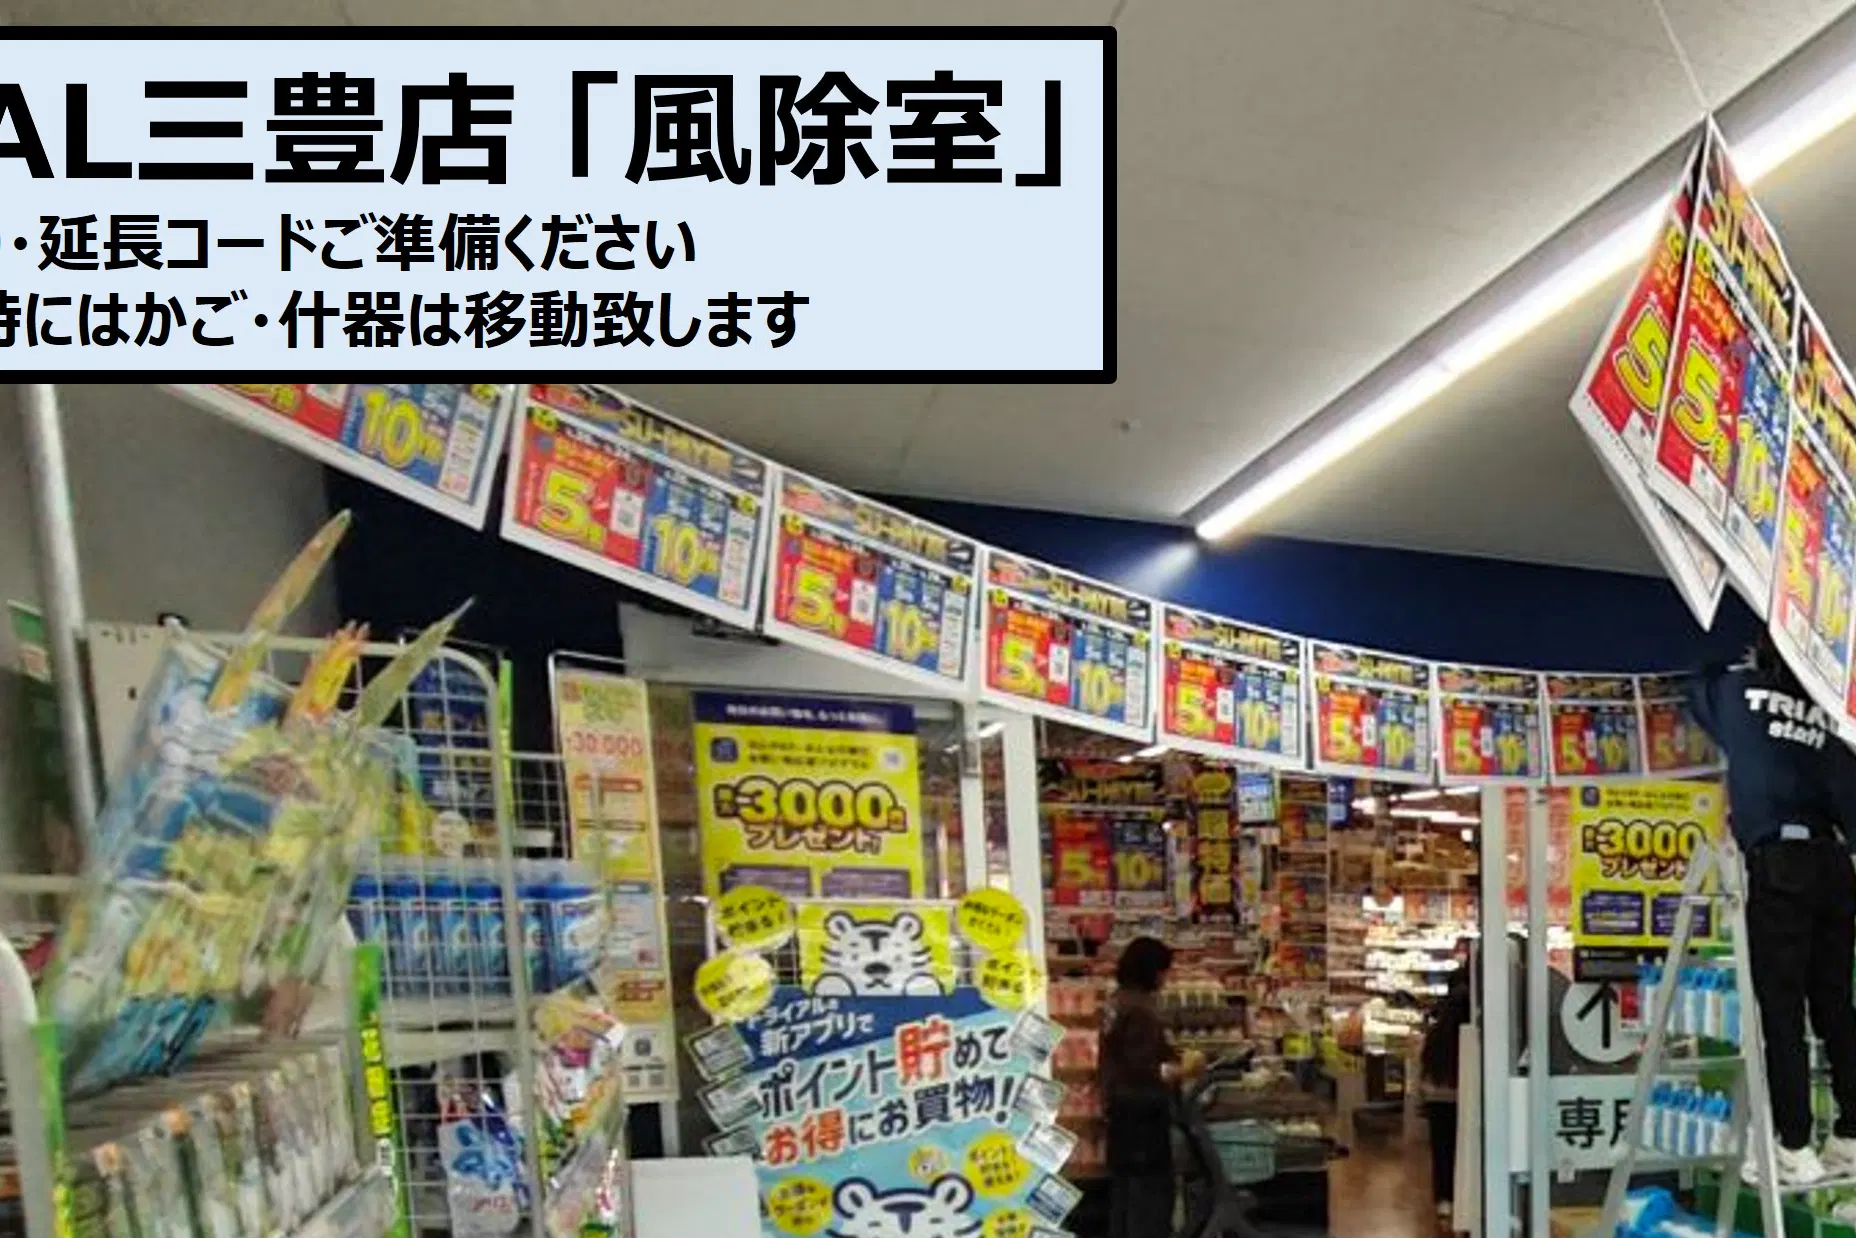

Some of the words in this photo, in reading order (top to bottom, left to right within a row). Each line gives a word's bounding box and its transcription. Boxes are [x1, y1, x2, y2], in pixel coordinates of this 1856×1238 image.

[1671, 342, 1722, 450] 5
[765, 1073, 1014, 1165] お得にお買物!
